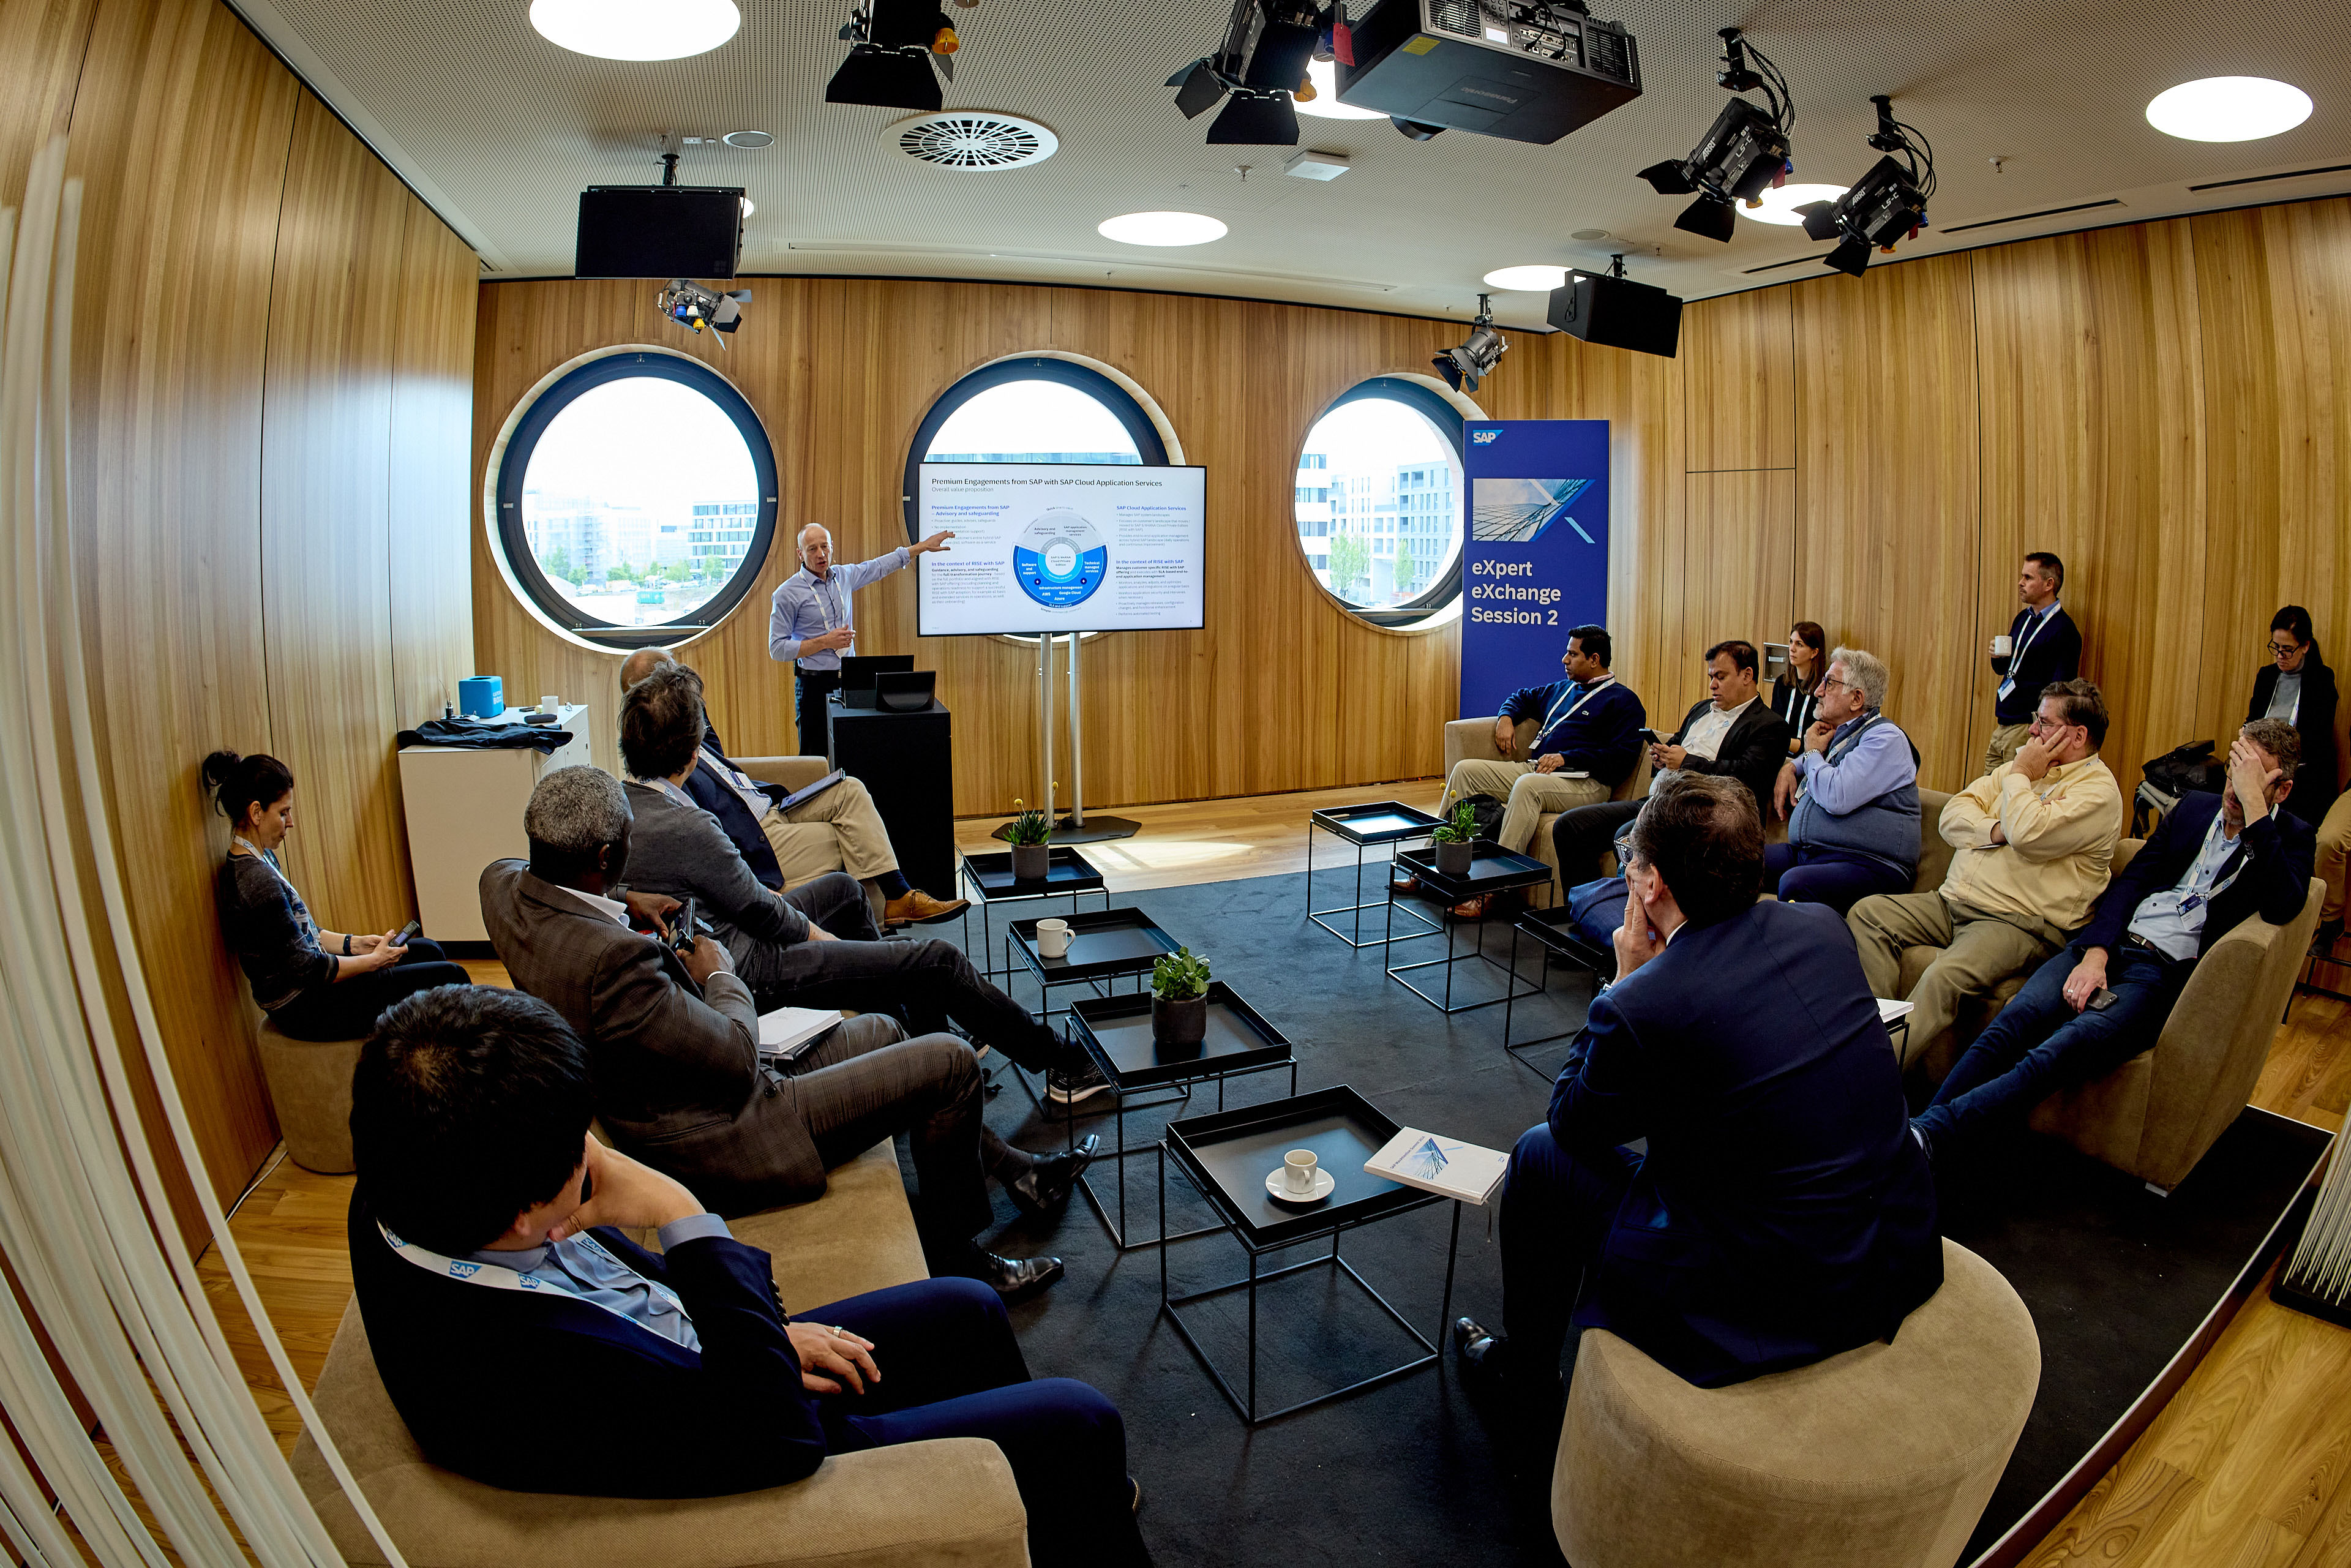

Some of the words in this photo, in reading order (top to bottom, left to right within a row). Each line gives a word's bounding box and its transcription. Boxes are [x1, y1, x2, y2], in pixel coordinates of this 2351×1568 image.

[1461, 88, 1518, 103] Panasonic
[1702, 140, 1715, 160] ARRI
[1736, 135, 1753, 157] LS-C
[1852, 189, 1866, 206] ARRI
[1881, 192, 1899, 209] LS-C
[1474, 432, 1496, 443] SAP
[1472, 559, 1532, 579] eXpert
[1471, 583, 1561, 605] eXchange
[1471, 607, 1542, 625] Session
[1547, 609, 1558, 626] 2
[387, 1232, 403, 1246] SAP
[583, 1237, 602, 1252] SAP
[451, 1263, 475, 1276] SAP
[520, 1277, 538, 1288] SAP
